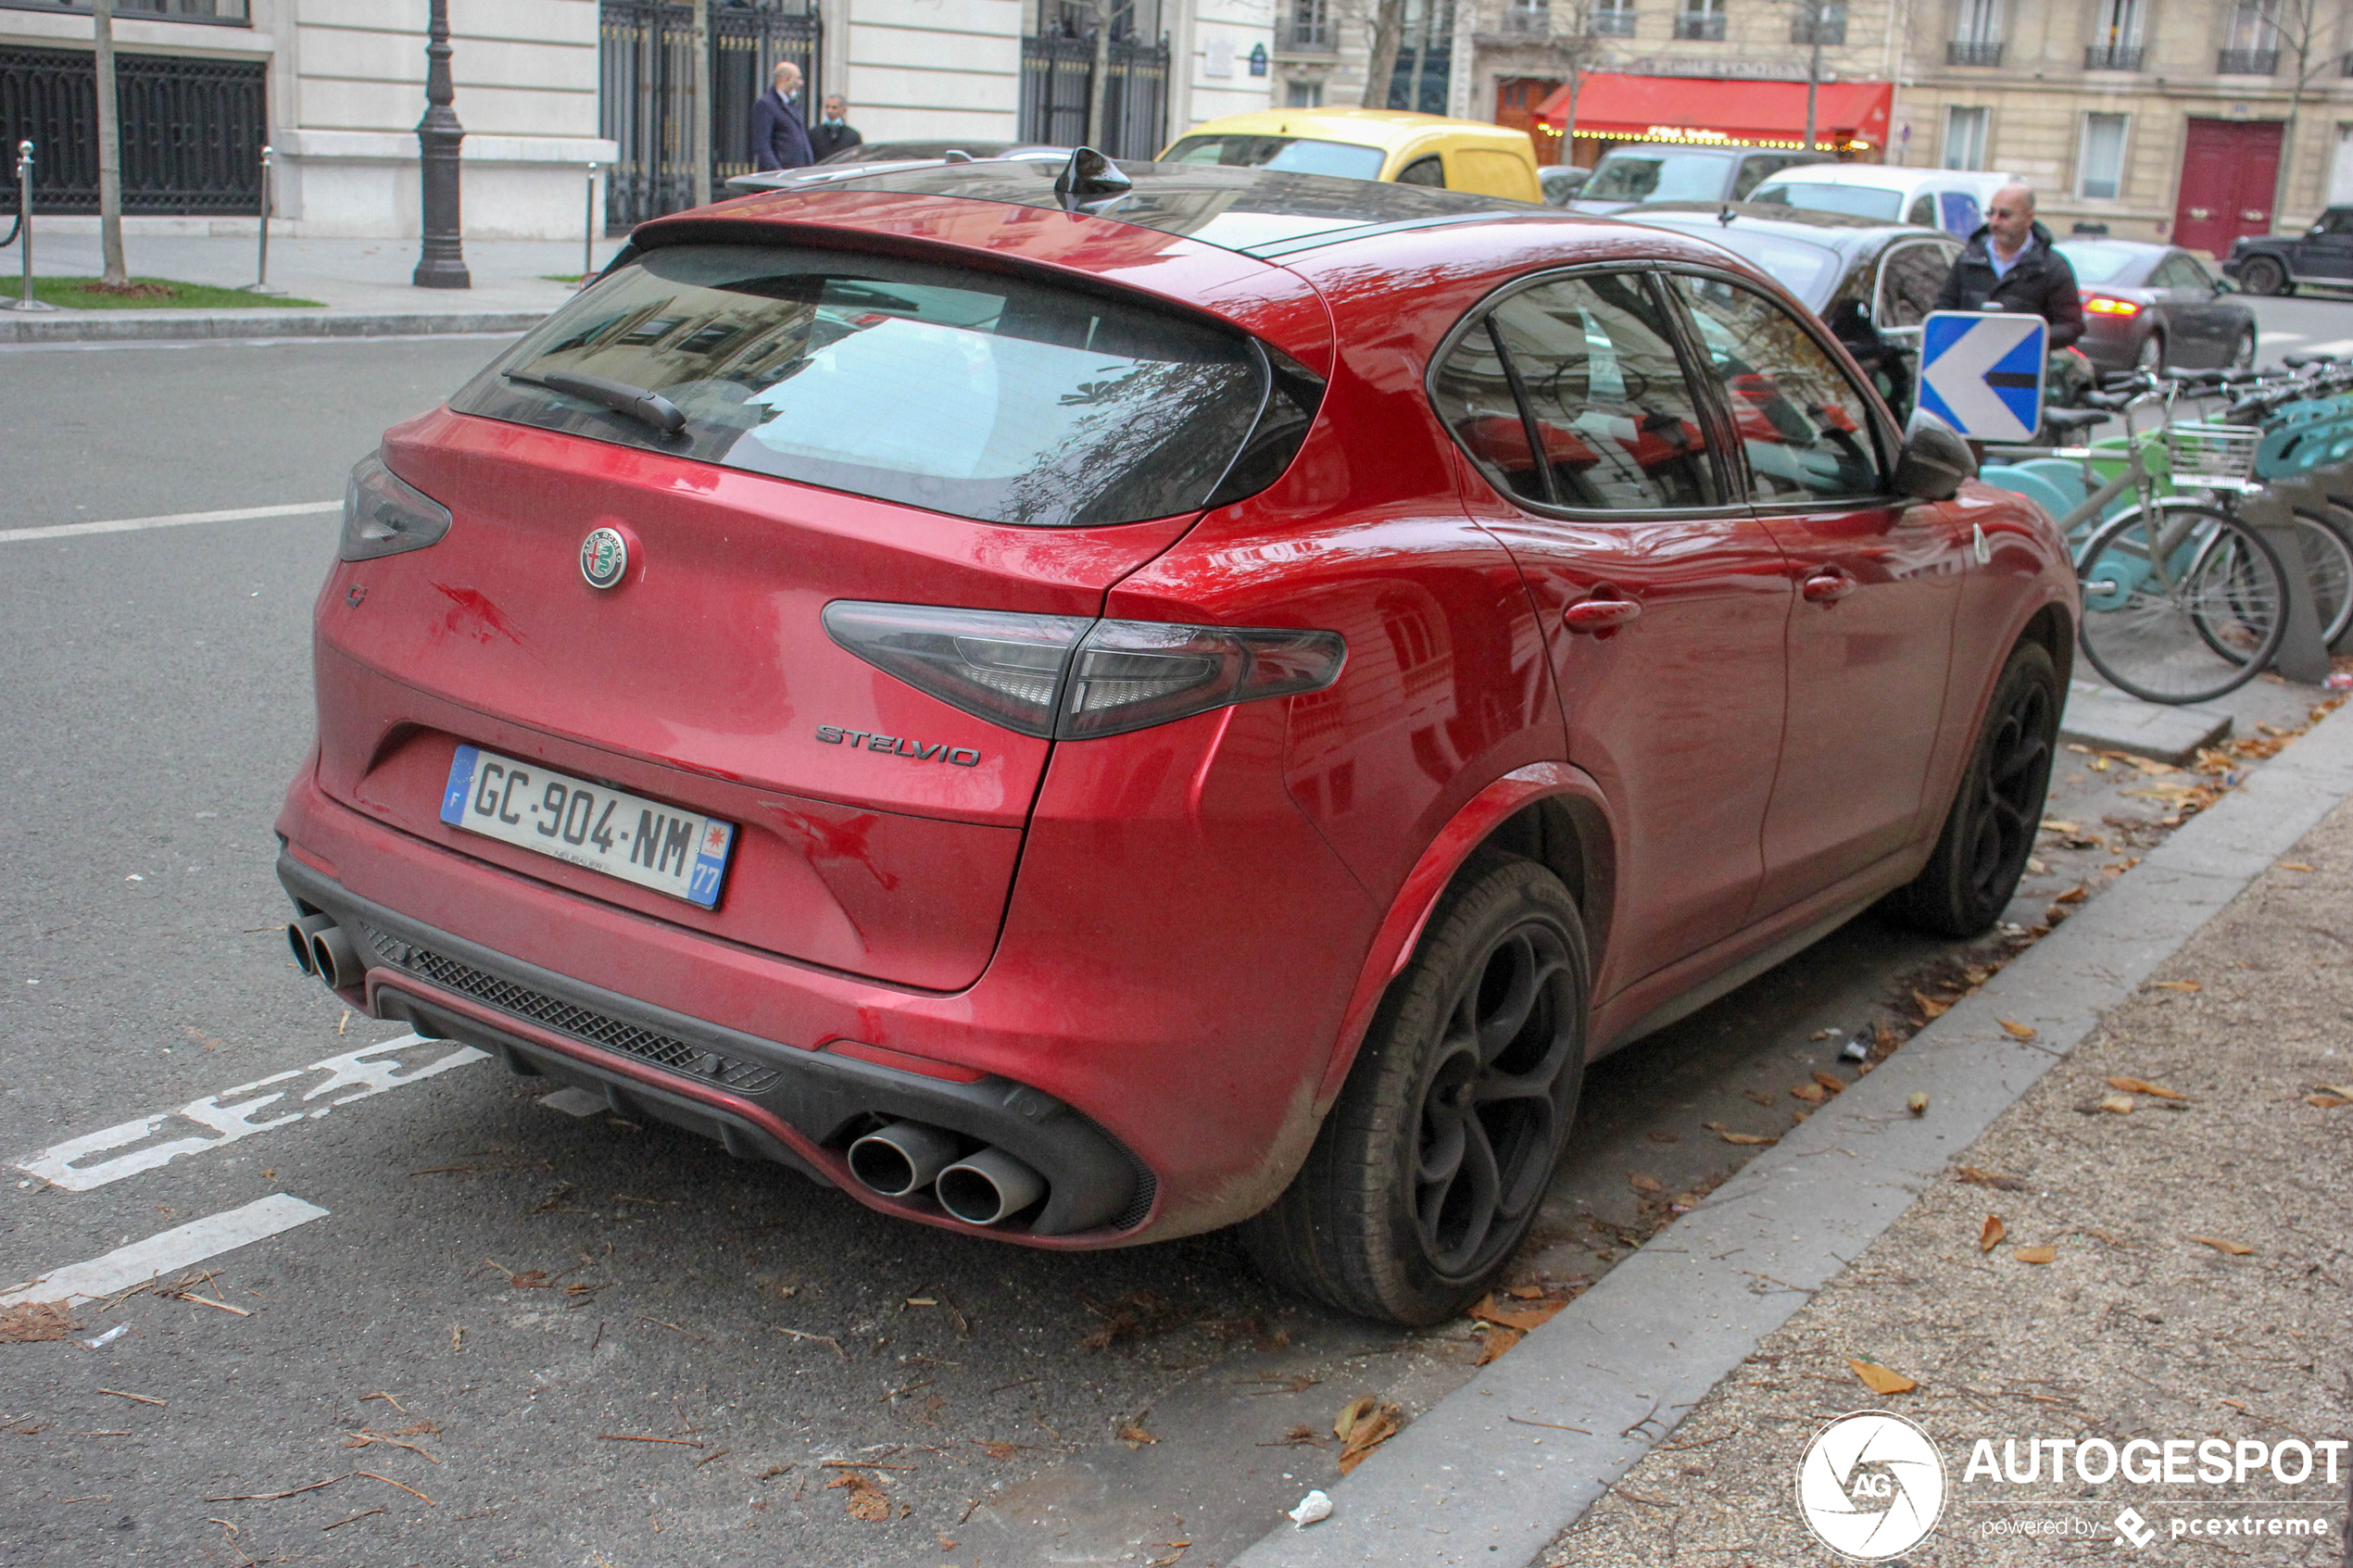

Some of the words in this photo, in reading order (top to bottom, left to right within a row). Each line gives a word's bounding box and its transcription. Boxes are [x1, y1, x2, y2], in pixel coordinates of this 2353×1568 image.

[815, 724, 980, 767] STELVIO
[449, 792, 460, 808] F
[693, 862, 720, 894] 77
